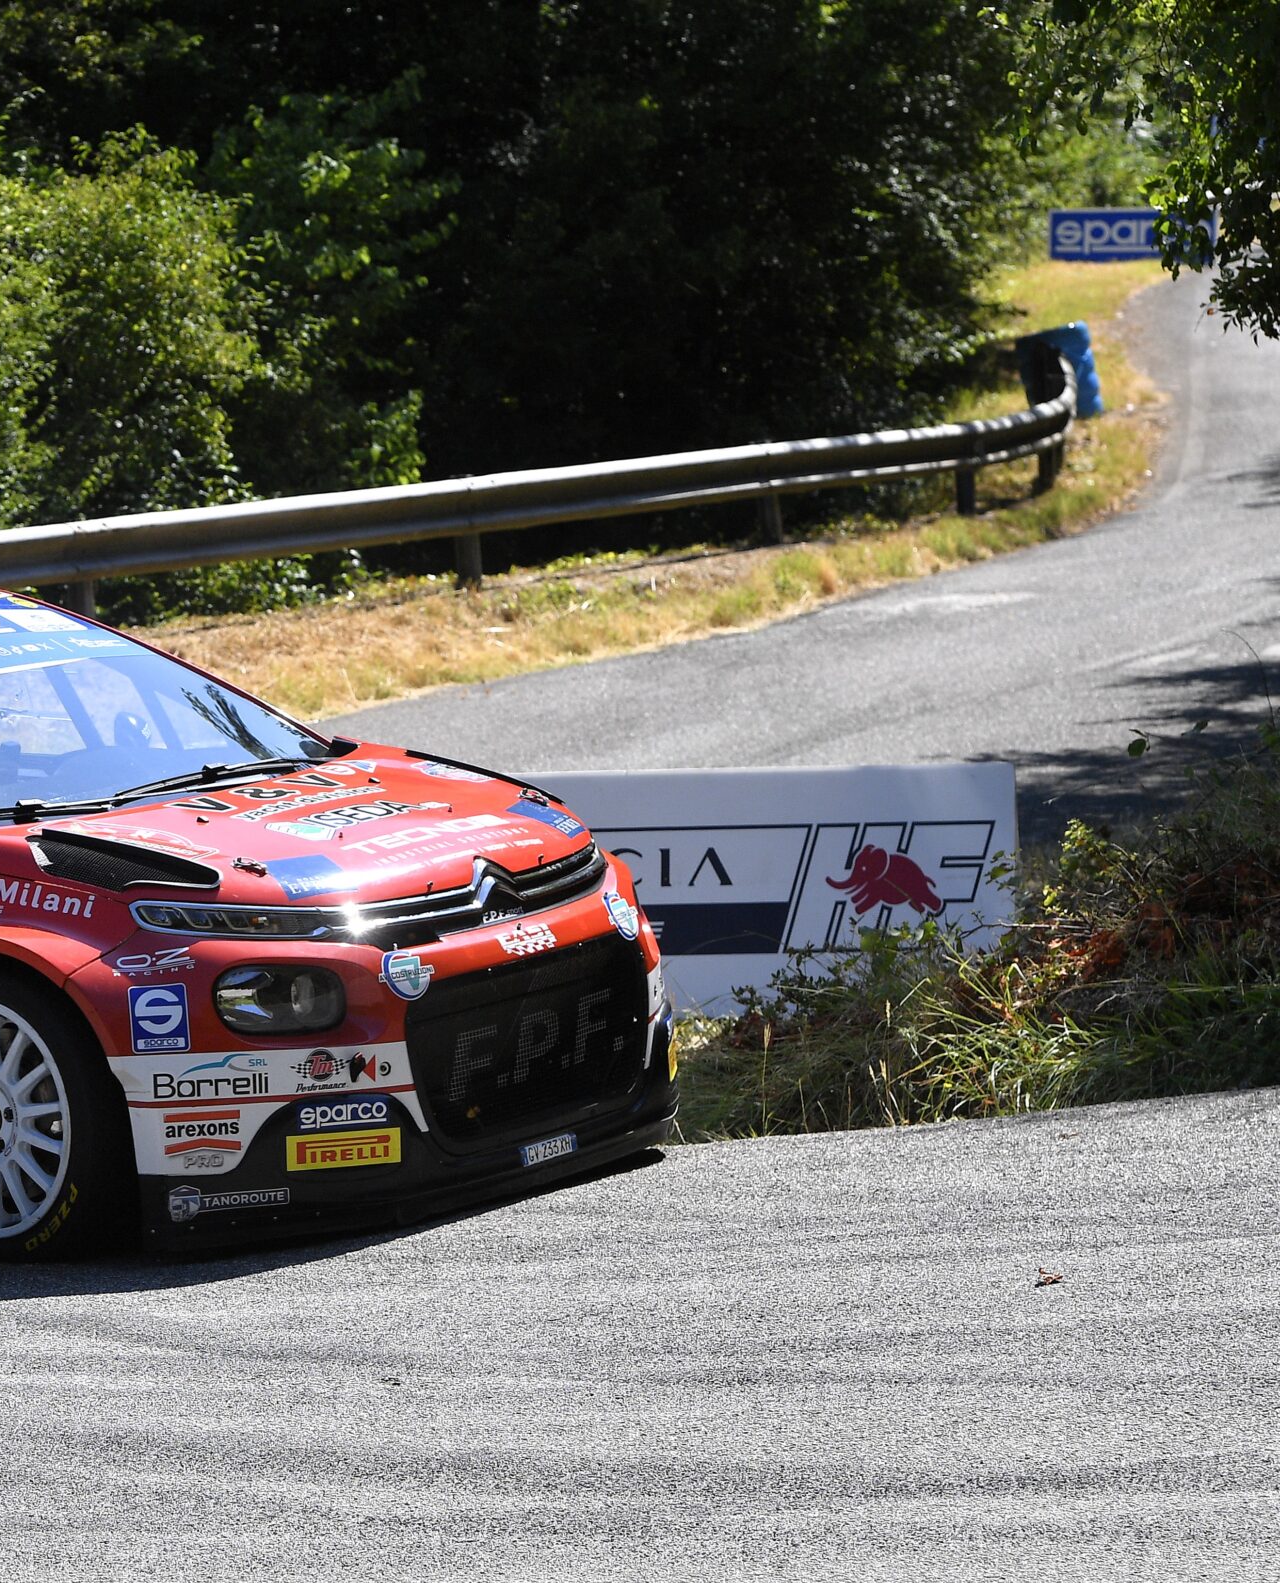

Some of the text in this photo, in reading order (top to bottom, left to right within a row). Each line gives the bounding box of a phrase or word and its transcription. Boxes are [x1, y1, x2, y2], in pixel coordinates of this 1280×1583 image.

[173, 774, 340, 812] V & V
[238, 785, 380, 820] yacht division
[374, 840, 454, 865] INDUSTRIAL
[457, 827, 529, 845] SOLUTIONS
[113, 963, 195, 977] RACING
[143, 1038, 179, 1047] sparco
[248, 1058, 268, 1067] SRL
[152, 1072, 269, 1099] Borrelli
[300, 1101, 388, 1129] sparco
[165, 1121, 240, 1139] arexons
[184, 1154, 225, 1169] PRO
[296, 1135, 391, 1165] PIRELLI
[528, 1135, 572, 1162] GV 233 XH
[204, 1191, 285, 1208] TANOROUTE
